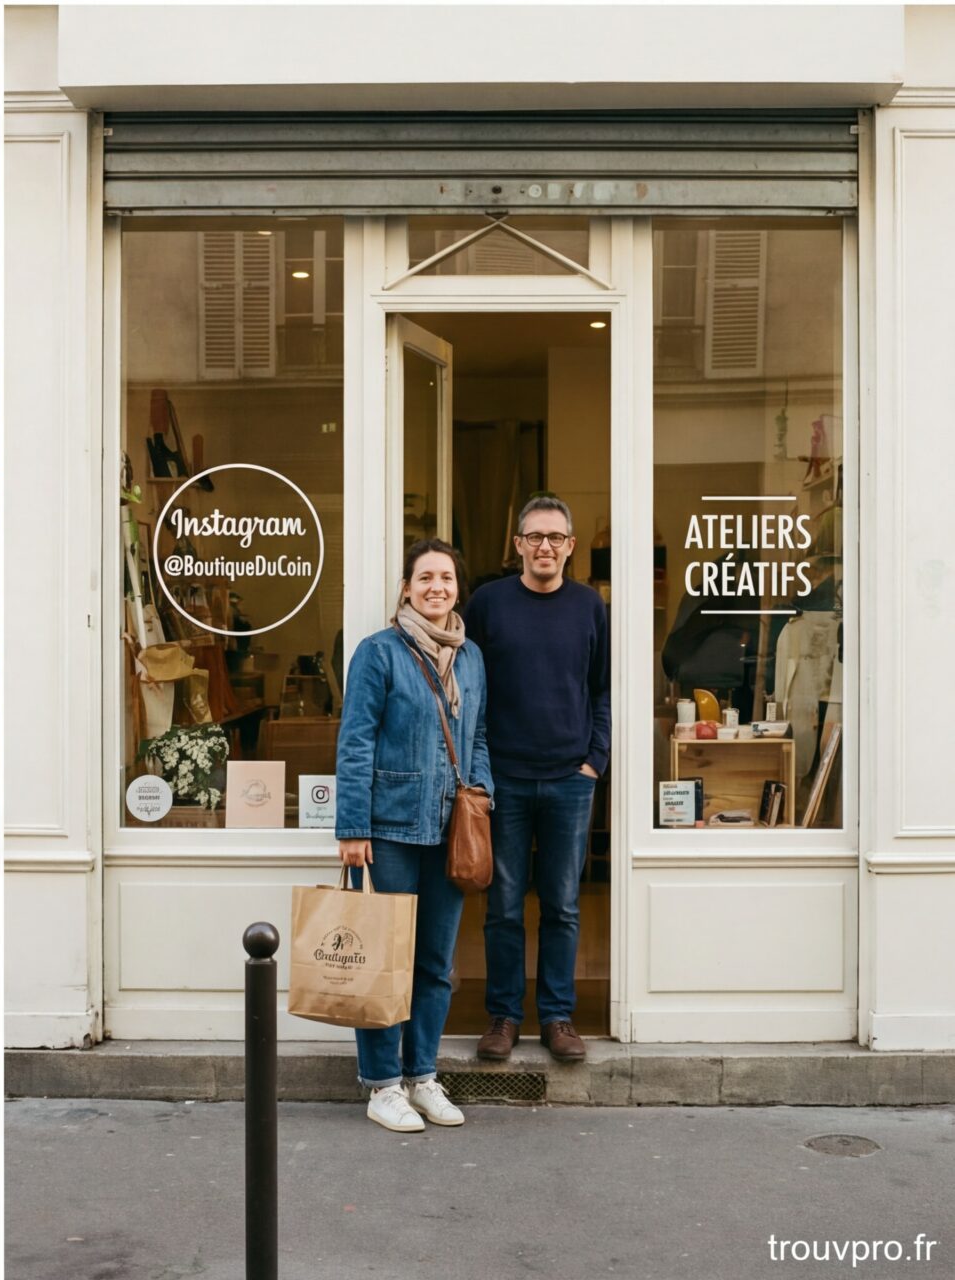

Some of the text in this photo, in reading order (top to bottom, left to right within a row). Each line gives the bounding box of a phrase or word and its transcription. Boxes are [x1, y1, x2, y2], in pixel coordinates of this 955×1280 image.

[170, 508, 306, 549] Instagram
[684, 514, 812, 549] ATELIERS
[164, 554, 312, 581] @BoutiqueDuCoin
[684, 553, 812, 597] CRÉATIFS
